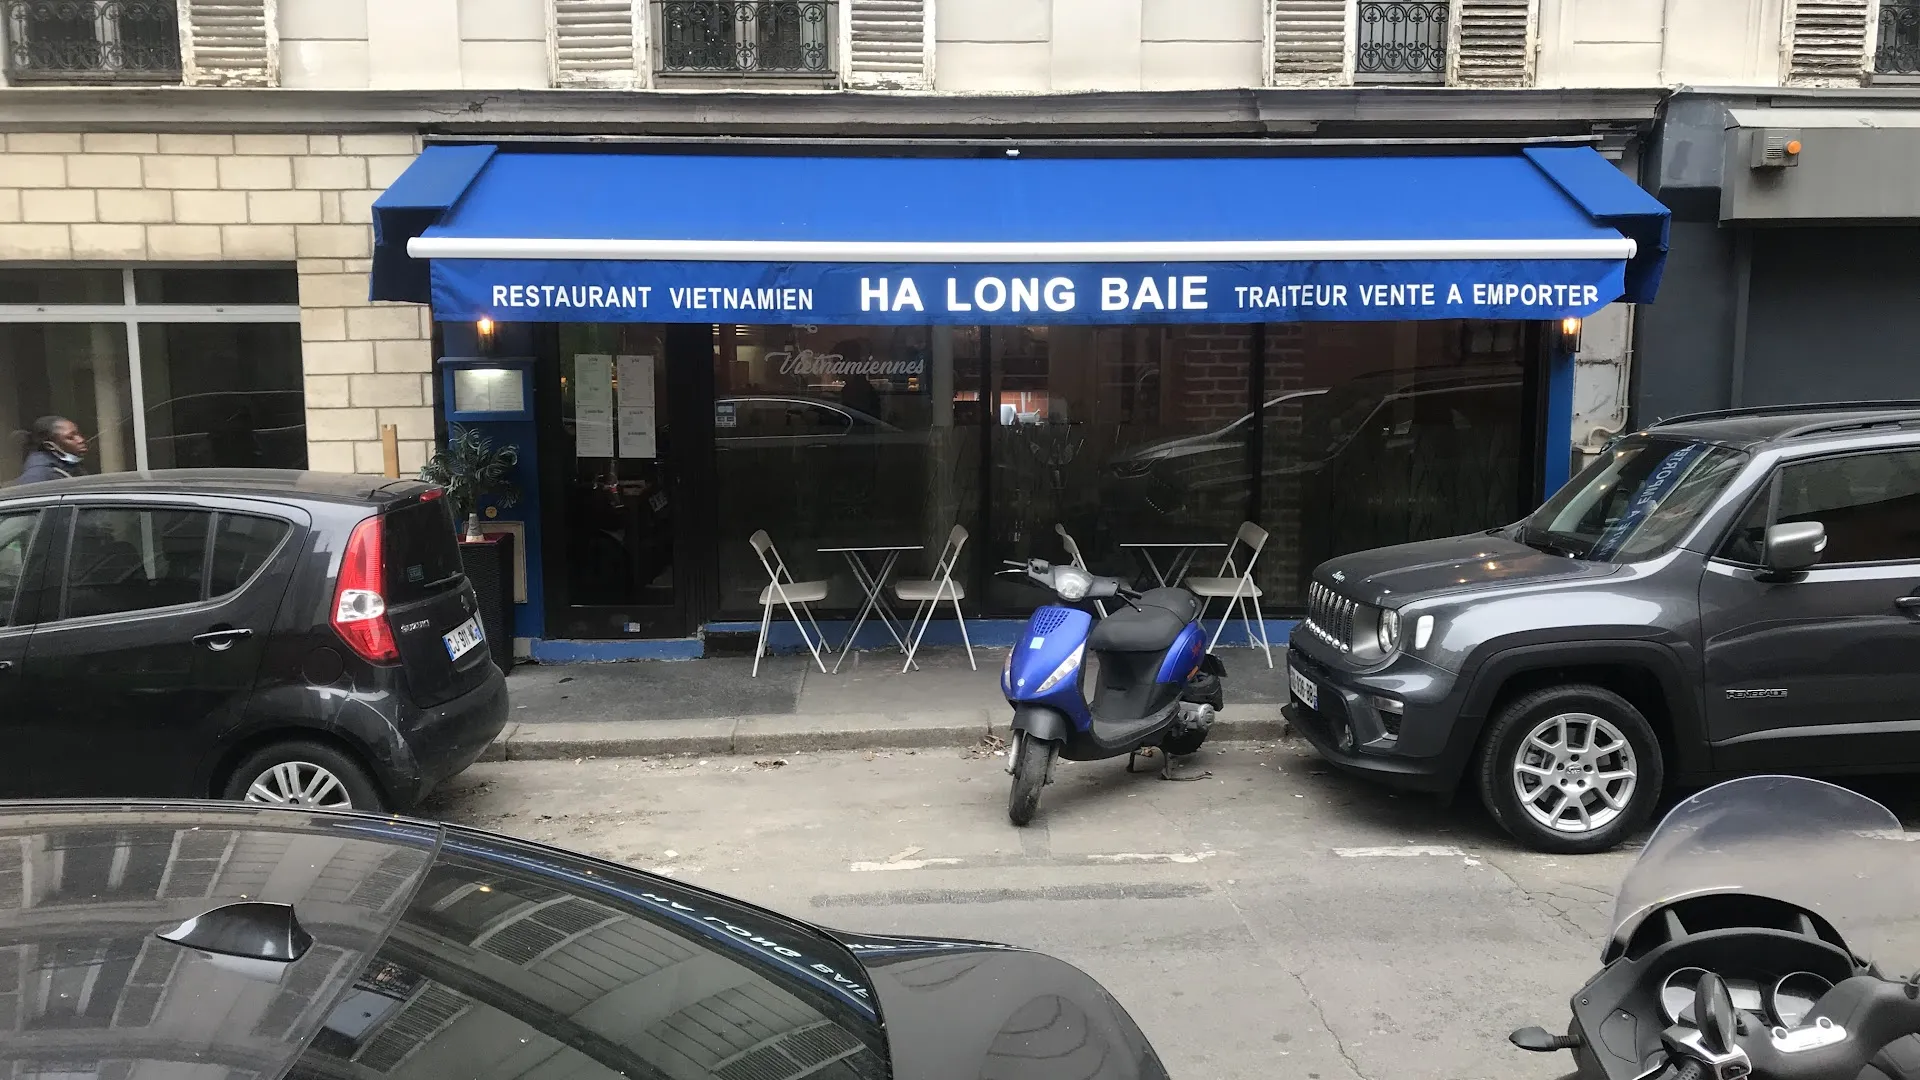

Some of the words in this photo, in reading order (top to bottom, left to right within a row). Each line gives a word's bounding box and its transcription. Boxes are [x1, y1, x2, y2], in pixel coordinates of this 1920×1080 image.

[492, 285, 652, 309] RESTAURANT
[669, 287, 813, 310] VIETNAMIEN
[860, 277, 925, 312] HA
[947, 276, 1076, 312] LONG
[1101, 275, 1208, 311] BAIE
[1235, 285, 1348, 308] TRAITEUR
[1359, 283, 1435, 306] VENTE
[1446, 284, 1464, 305] A
[1473, 284, 1599, 306] EMPORTER
[764, 350, 924, 375] Vietnamiennes
[1726, 688, 1788, 699] RENEGADE
